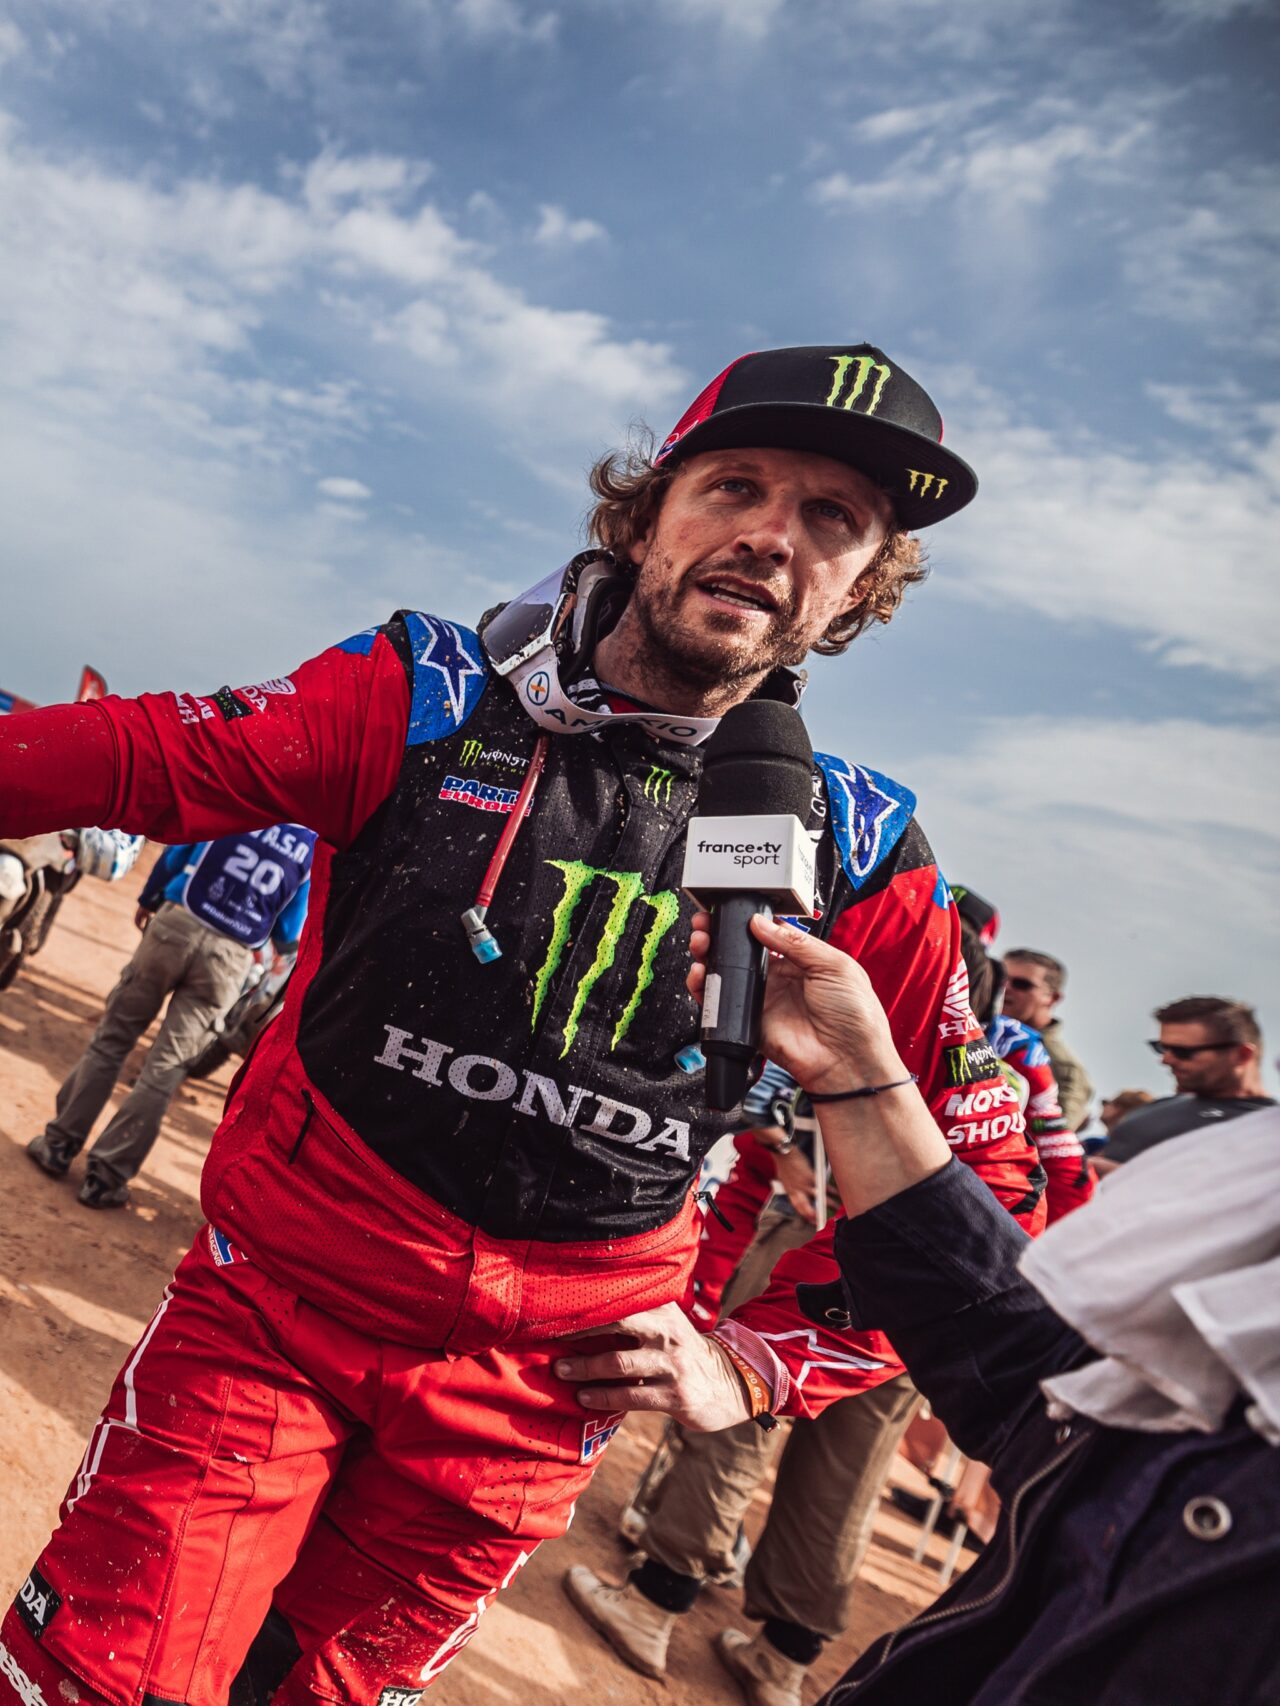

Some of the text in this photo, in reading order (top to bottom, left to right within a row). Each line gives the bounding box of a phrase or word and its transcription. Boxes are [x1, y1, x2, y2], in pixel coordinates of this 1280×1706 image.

[442, 776, 535, 806] PART
[223, 844, 284, 895] 20
[733, 854, 780, 868] sport
[373, 1024, 692, 1162] HONDA
[753, 1387, 762, 1399] 60
